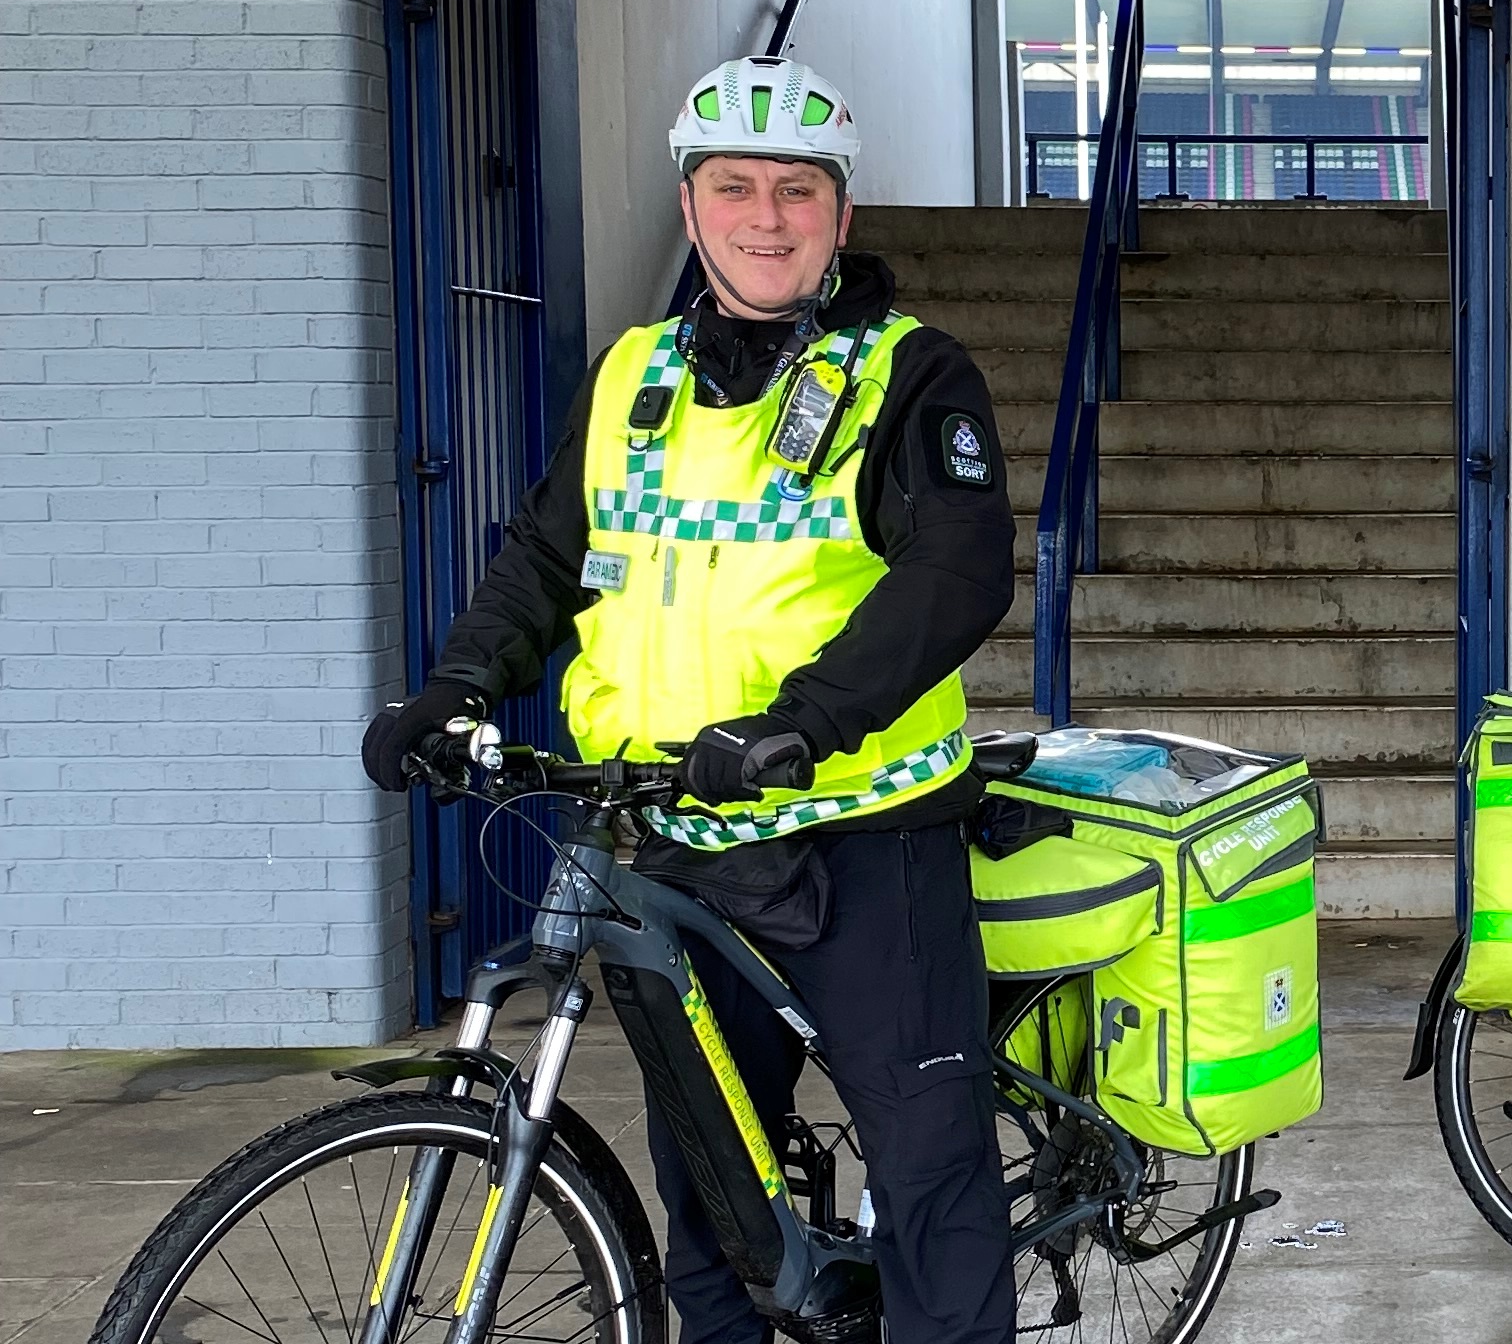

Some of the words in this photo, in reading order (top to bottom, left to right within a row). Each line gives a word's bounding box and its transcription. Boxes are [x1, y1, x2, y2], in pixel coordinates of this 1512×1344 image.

[955, 465, 985, 481] SORT
[1199, 831, 1246, 867] CYCLE
[1240, 794, 1303, 837] RESPONSE
[1247, 824, 1281, 852] UNIT
[698, 1022, 721, 1065] CYCLE
[718, 1064, 755, 1136] RESPONSE
[750, 1135, 770, 1166] UNIT
